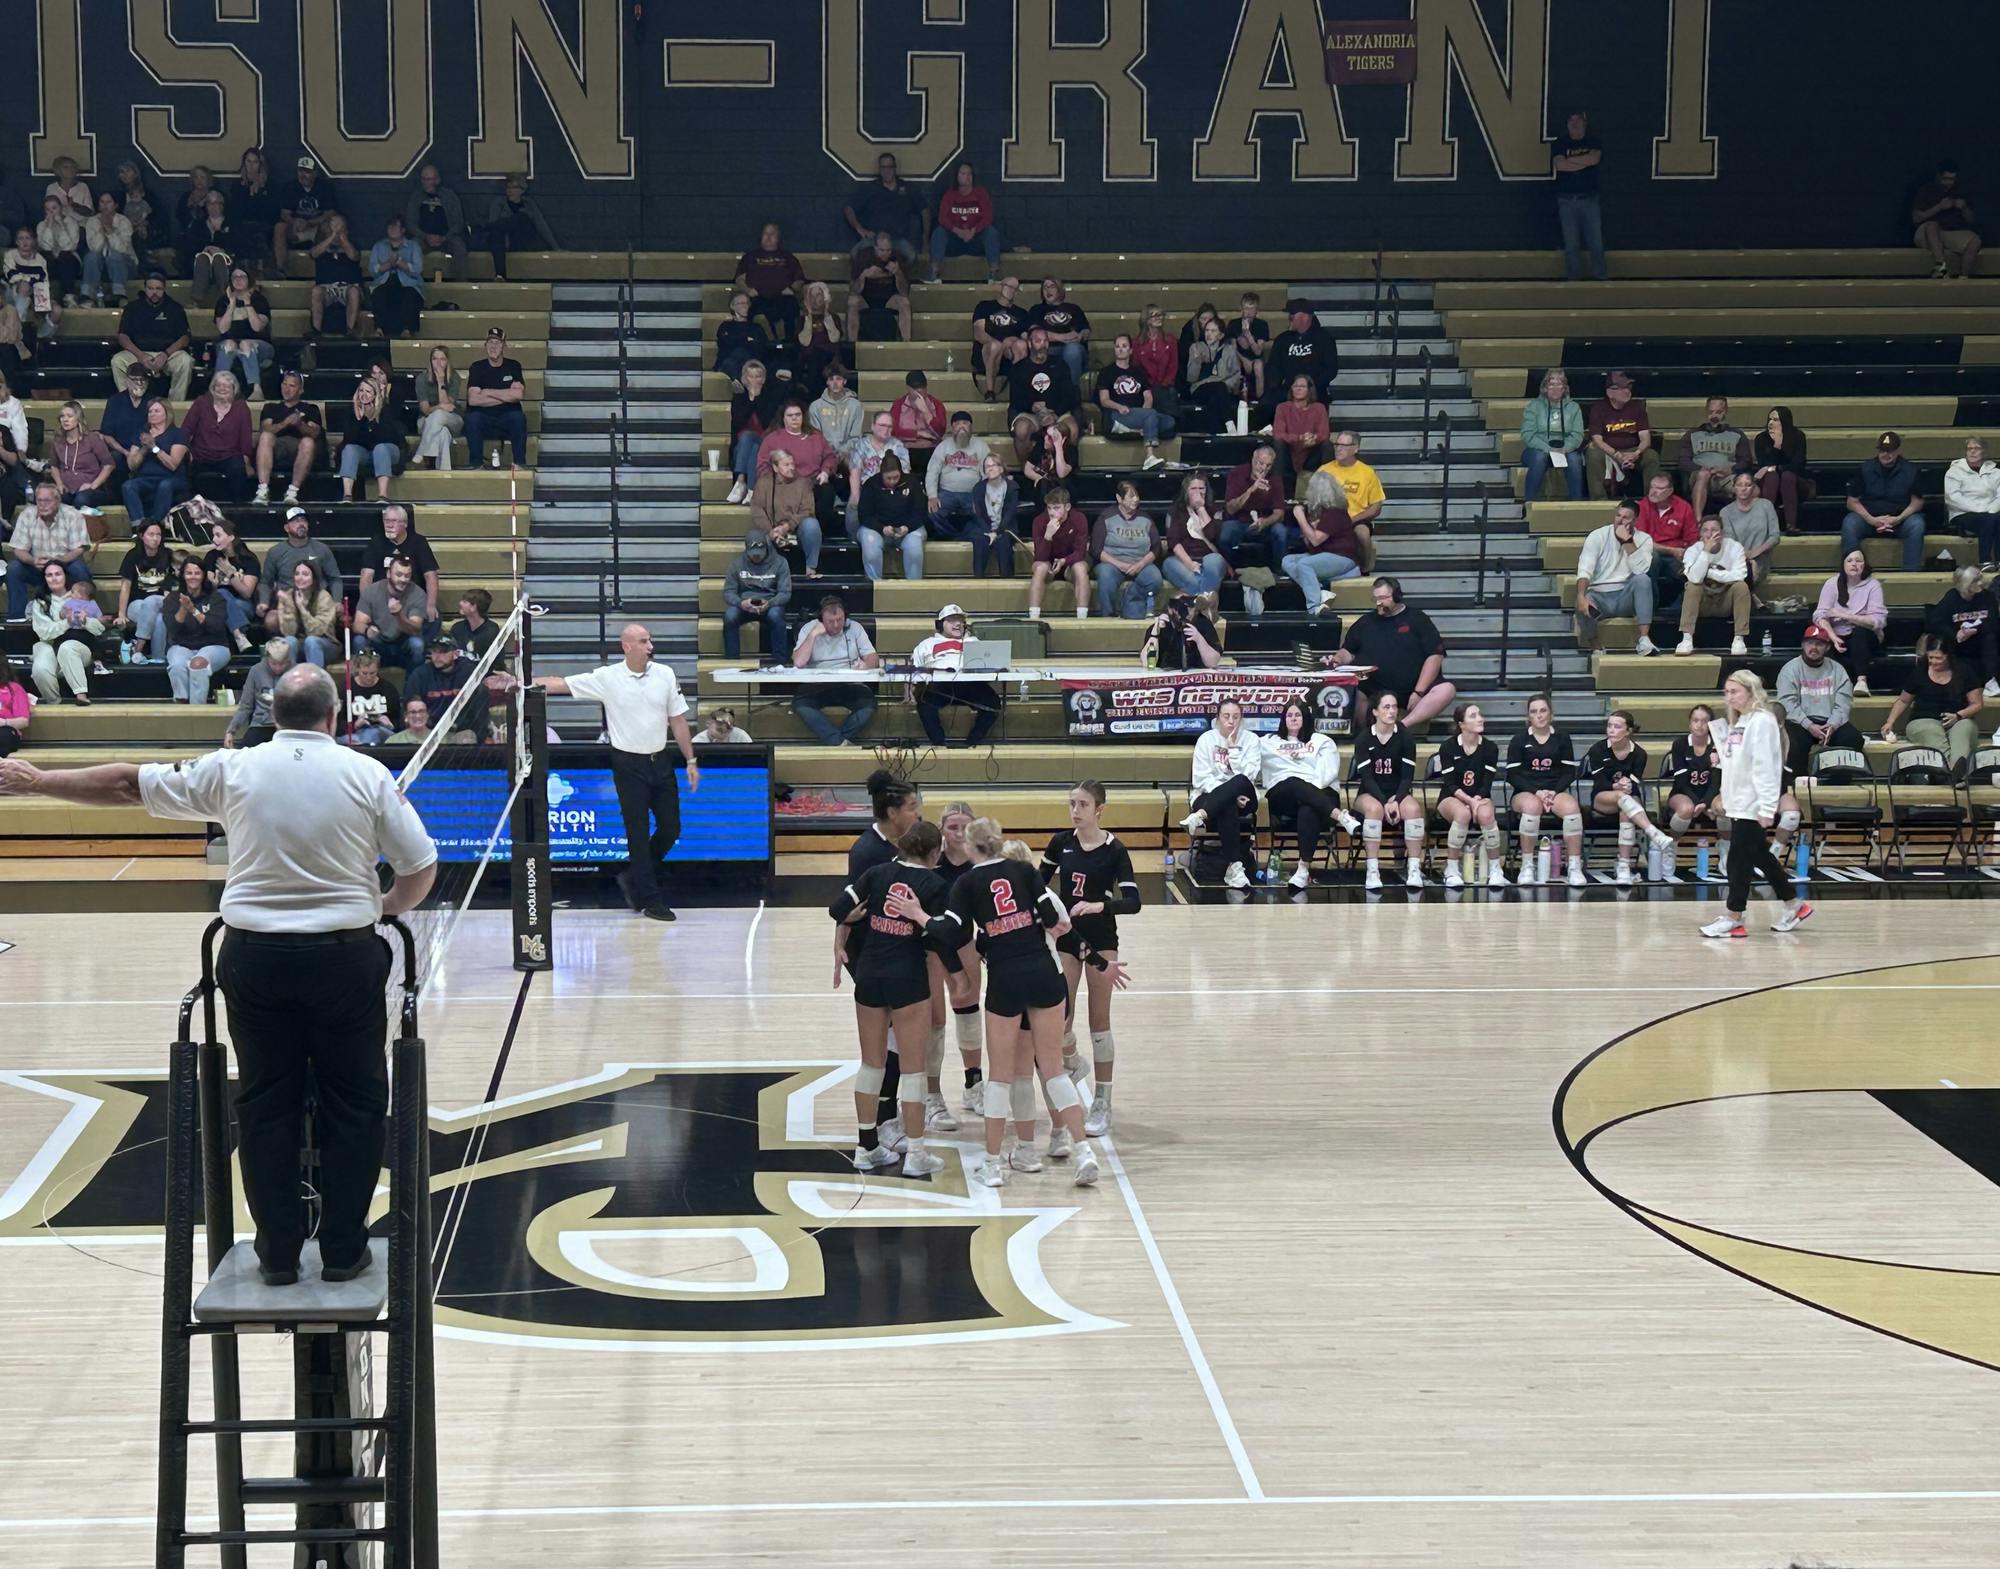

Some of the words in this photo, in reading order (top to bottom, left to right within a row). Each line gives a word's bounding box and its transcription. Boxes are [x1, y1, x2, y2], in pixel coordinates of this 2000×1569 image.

[1326, 33, 1416, 50] ALEXANDRIA
[1346, 55, 1395, 71] TIGERS
[1112, 688, 1175, 708] WHS
[548, 810, 595, 824] RION
[1072, 872, 1087, 898] 7
[989, 877, 1018, 917] 2
